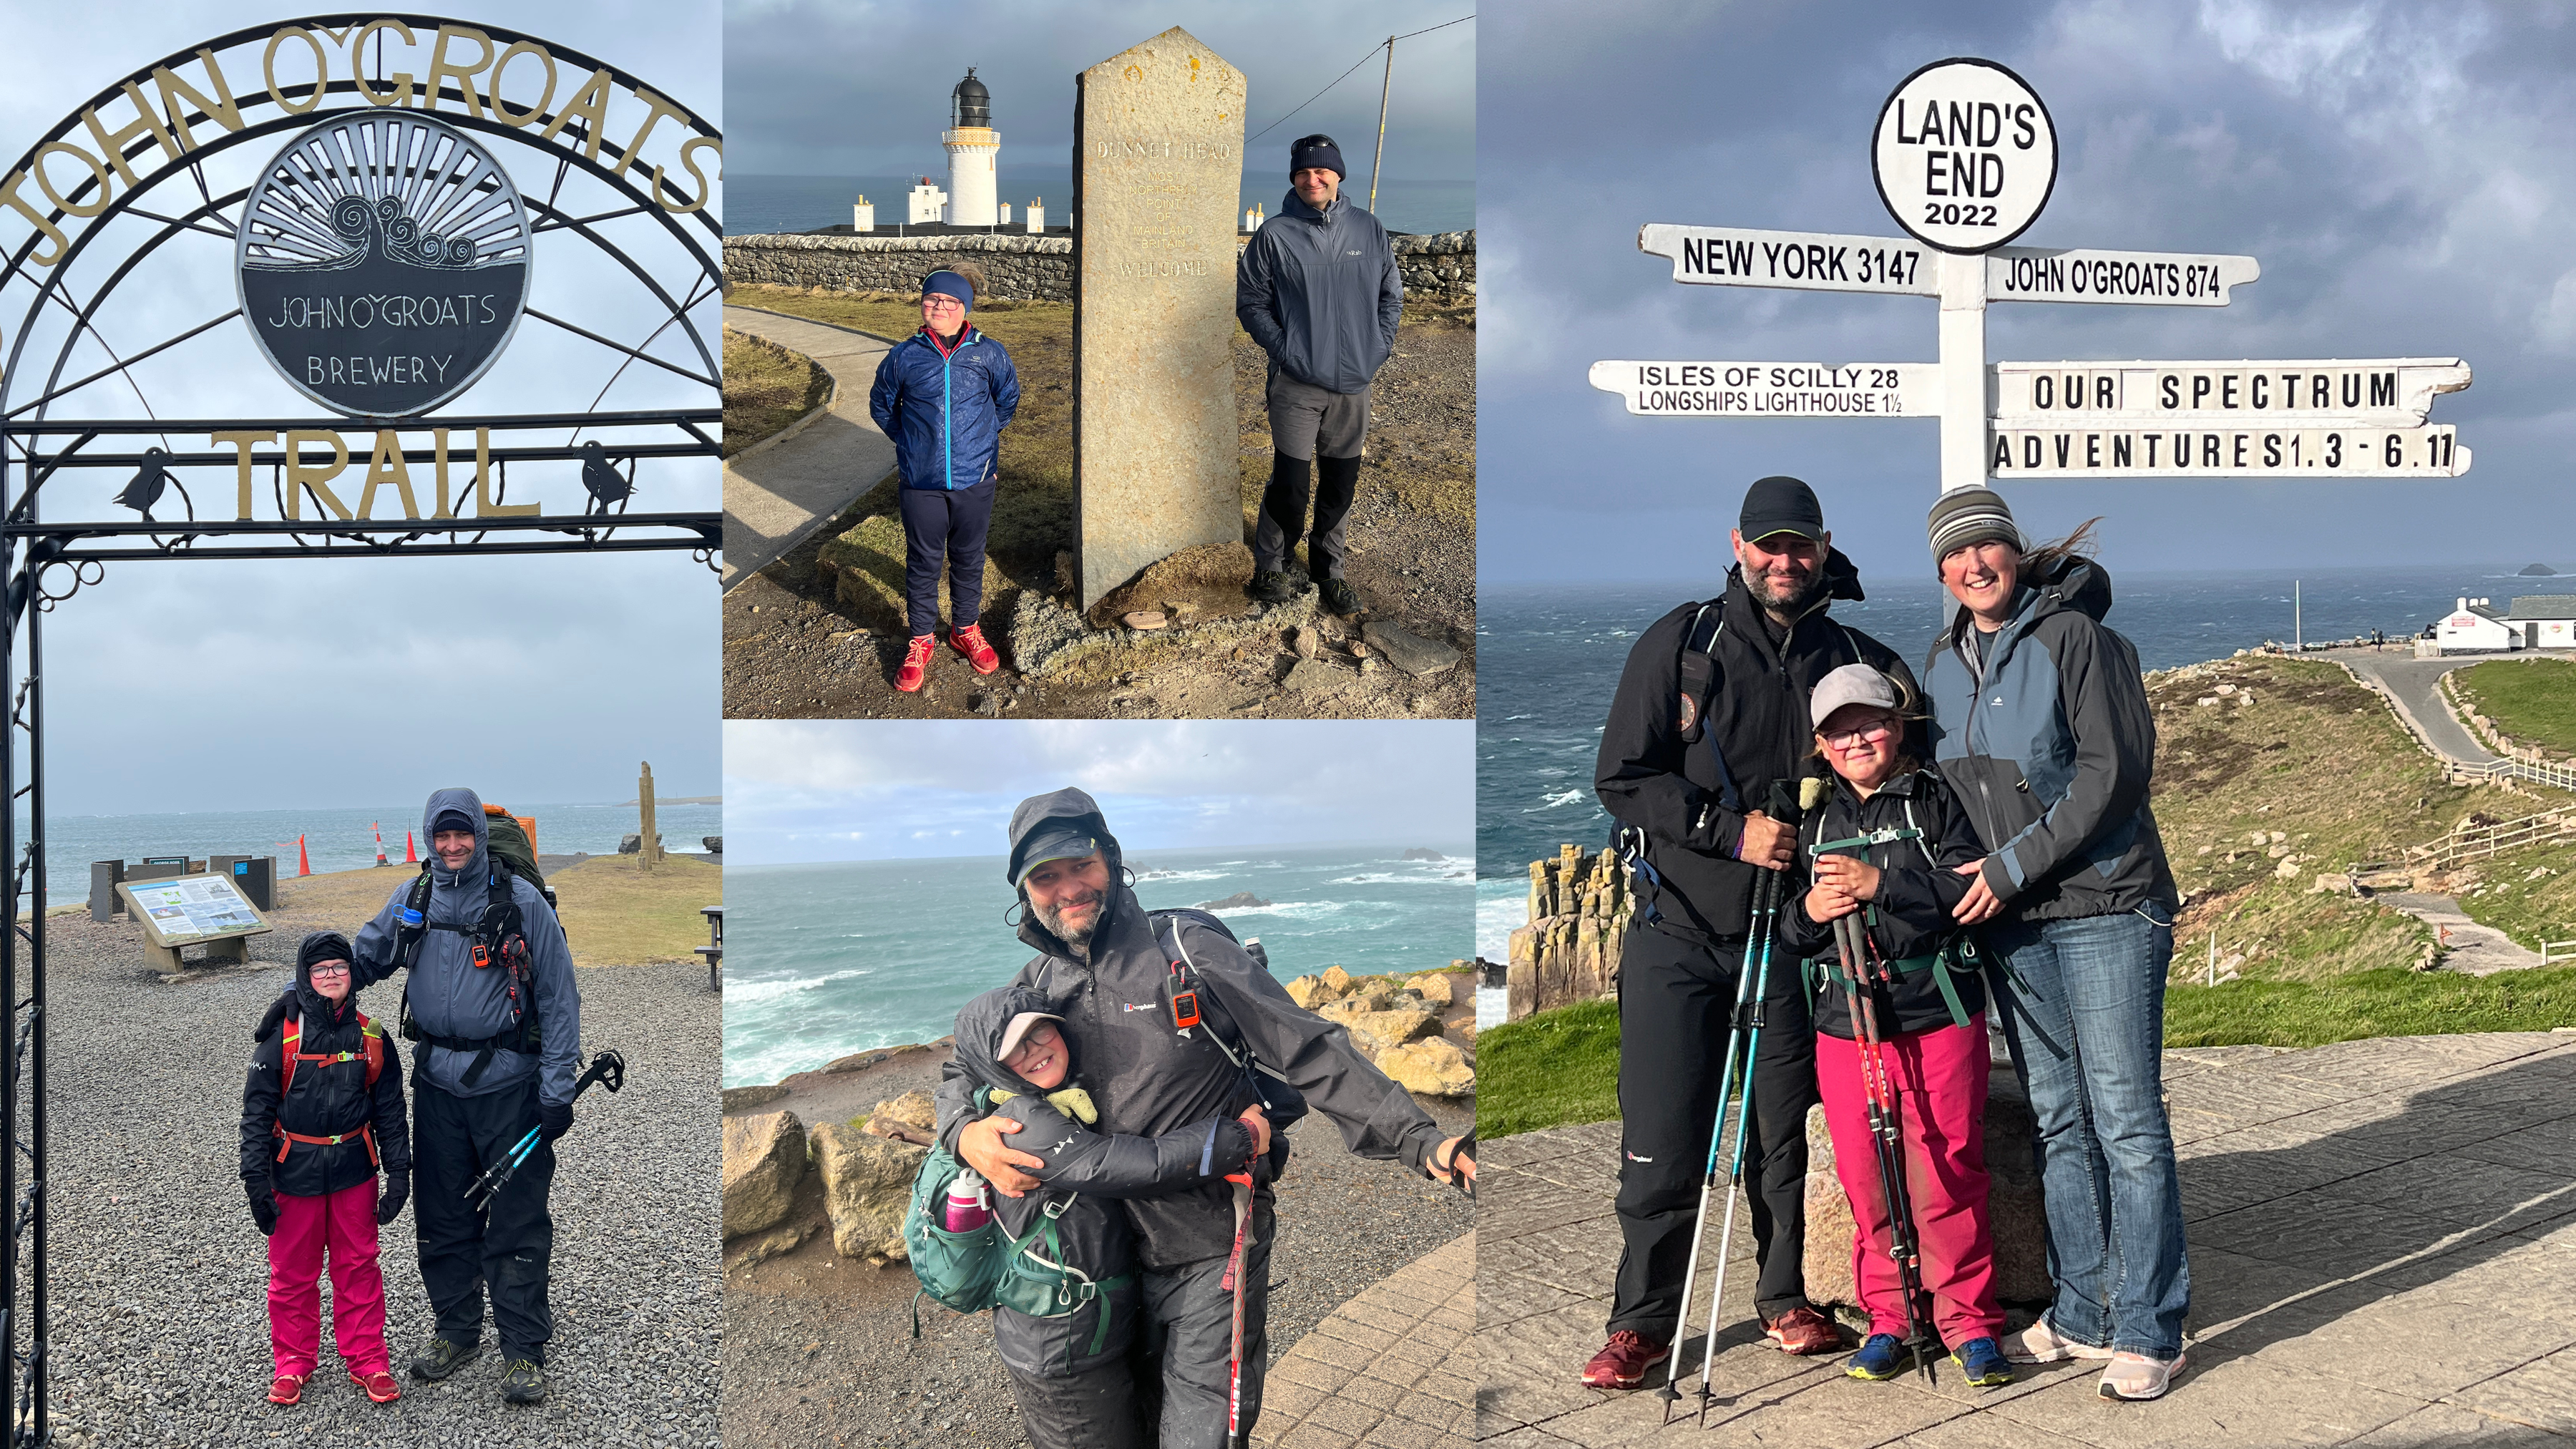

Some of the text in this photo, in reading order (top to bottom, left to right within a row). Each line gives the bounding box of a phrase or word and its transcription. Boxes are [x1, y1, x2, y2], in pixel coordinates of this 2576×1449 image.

[1898, 98, 2036, 150] LAND'S
[0, 48, 245, 267] JOHN
[1098, 141, 1230, 160] DUNNET HEAD
[1148, 172, 1181, 182] MOST
[1927, 150, 2004, 198] END
[1129, 185, 1198, 195] NORTHERLY
[1147, 198, 1181, 208] POINT
[1156, 212, 1172, 222] OF
[1924, 203, 1997, 227] 2022
[1133, 225, 1194, 235] MAINLAND
[1141, 238, 1186, 249] BRITAIN
[1119, 260, 1207, 278] WELCOME
[1684, 238, 1919, 285] NEW YORK 3147
[2005, 257, 2220, 298] JOHN O'GROATS 874
[269, 296, 344, 328] JOHN
[308, 355, 452, 385] BREWERY
[1639, 366, 1899, 389] ISLES OF SCILLY 28
[1639, 390, 1747, 411] LONGSHIPS
[1755, 392, 1875, 413] LIGHTHOUSE
[2035, 373, 2396, 409] OUR SPECTRUM
[2385, 434, 2454, 469] 6.11
[211, 427, 541, 522] TRAIL
[1232, 1377, 1241, 1420] LEKI
